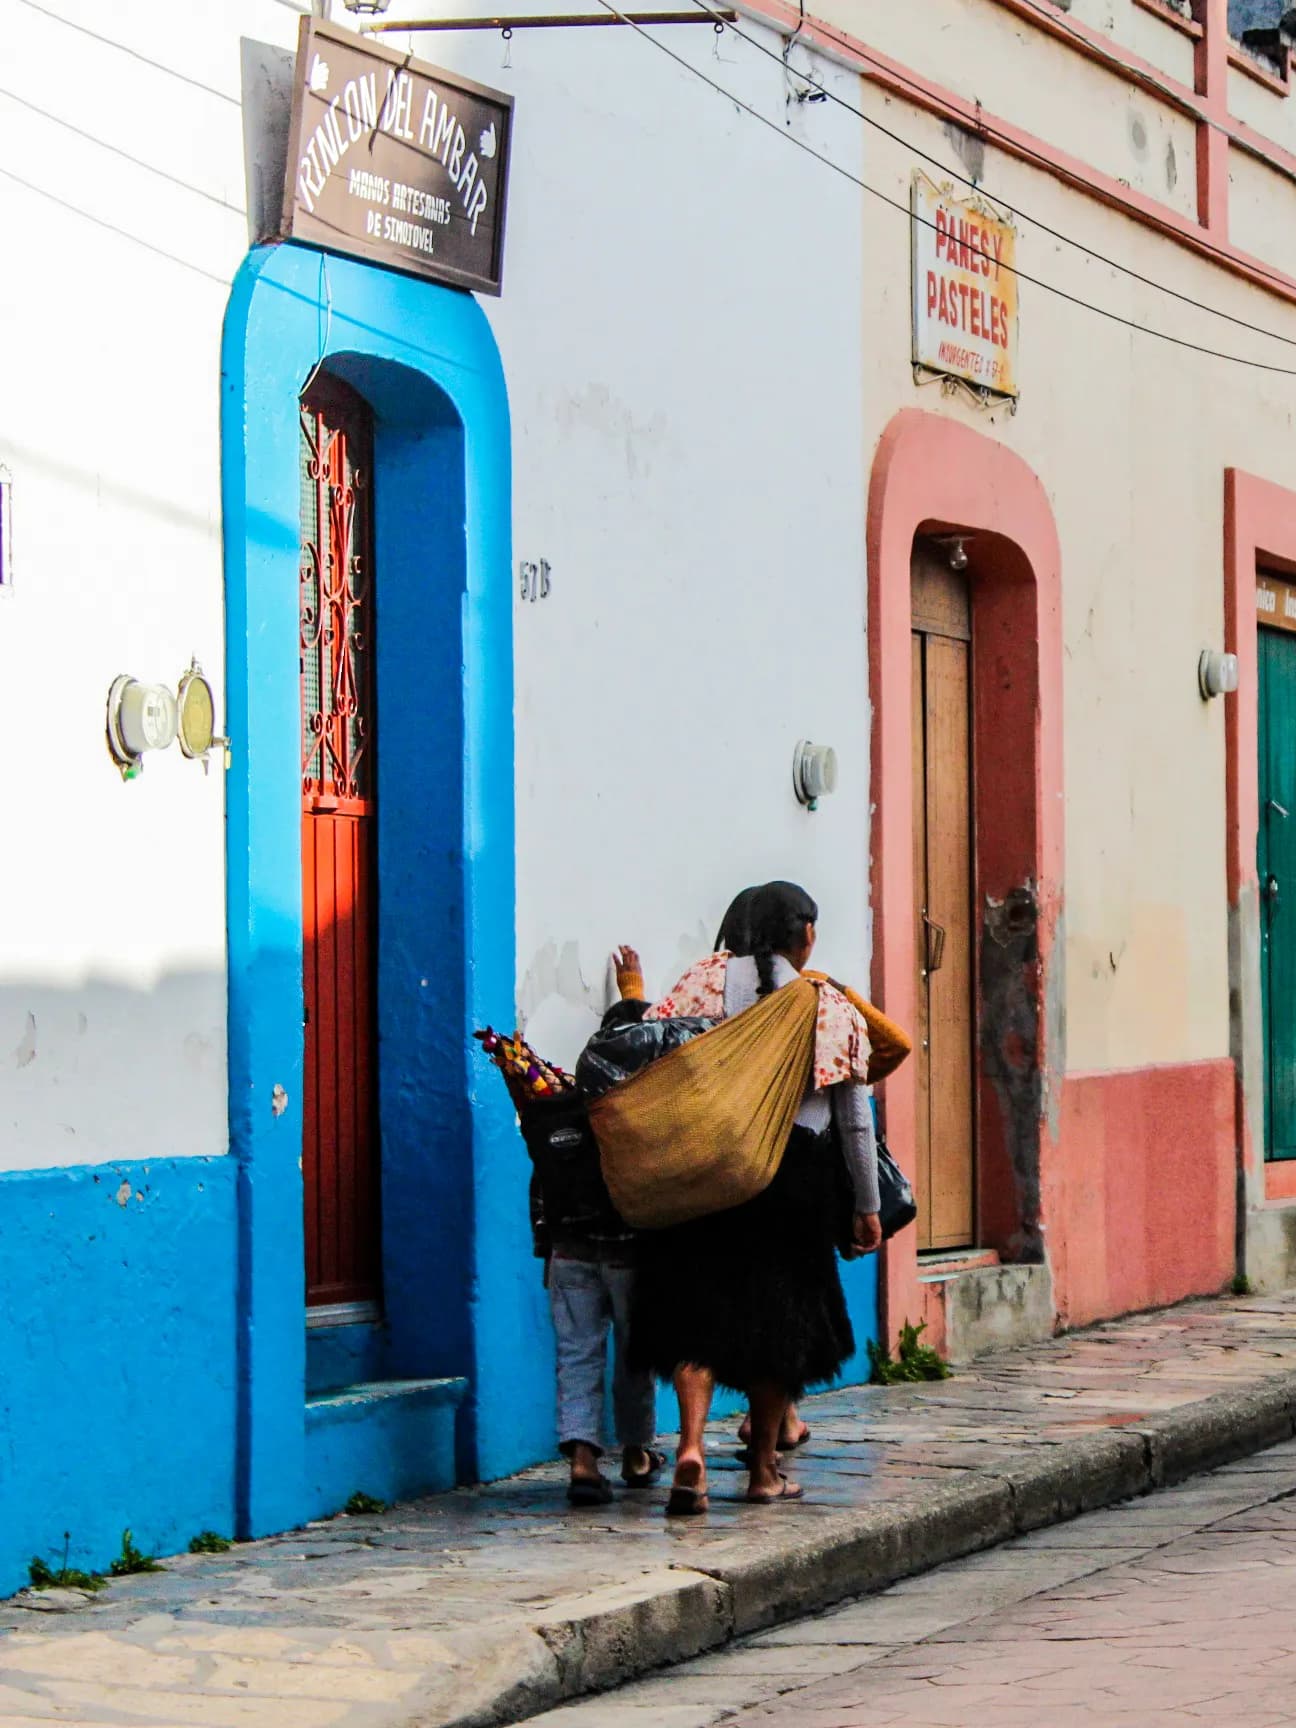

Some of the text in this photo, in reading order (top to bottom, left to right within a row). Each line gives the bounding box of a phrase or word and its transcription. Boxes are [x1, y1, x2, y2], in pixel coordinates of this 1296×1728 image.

[383, 68, 414, 140] DEL
[419, 88, 488, 237] AMBAR
[348, 168, 451, 225] MANOS ARTESANAS
[367, 209, 382, 238] DE
[935, 208, 1004, 283] PANES Y
[927, 269, 1009, 350] PASTELES
